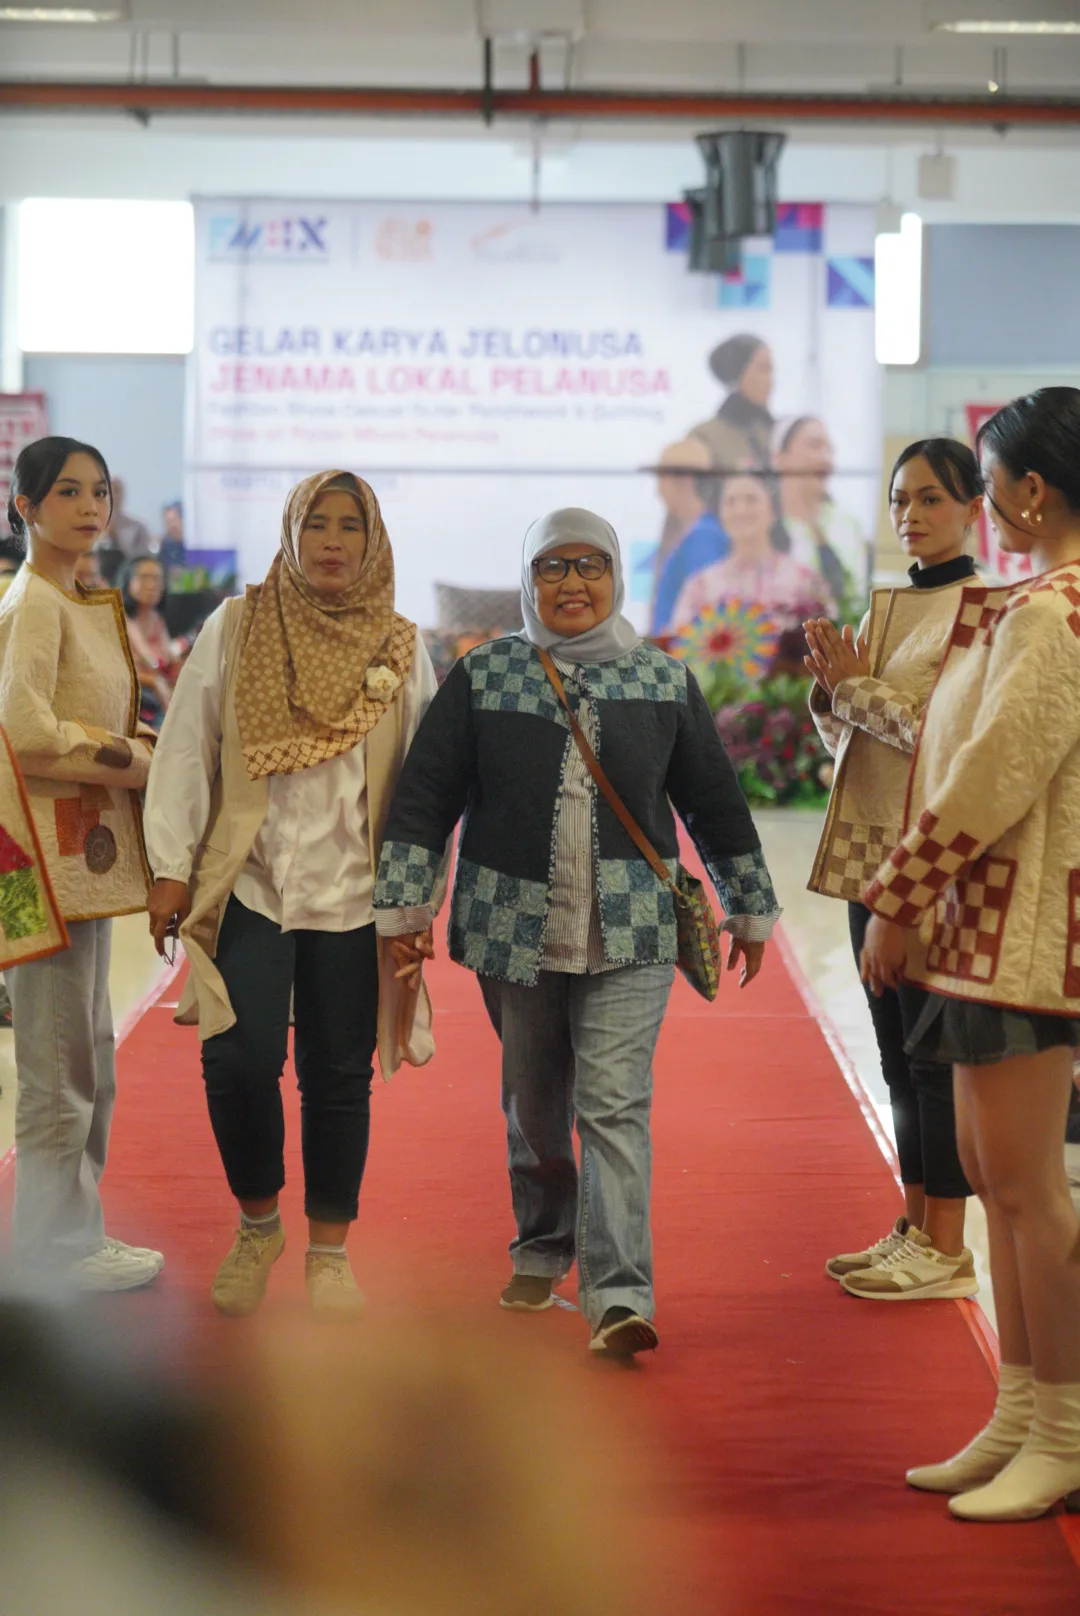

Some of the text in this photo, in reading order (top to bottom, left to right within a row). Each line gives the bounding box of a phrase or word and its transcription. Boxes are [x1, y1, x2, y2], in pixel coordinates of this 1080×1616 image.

[209, 327, 642, 359] GELAR KARYA JELONUSA
[209, 365, 671, 396] JENAMA LOKAL PELANUSA
